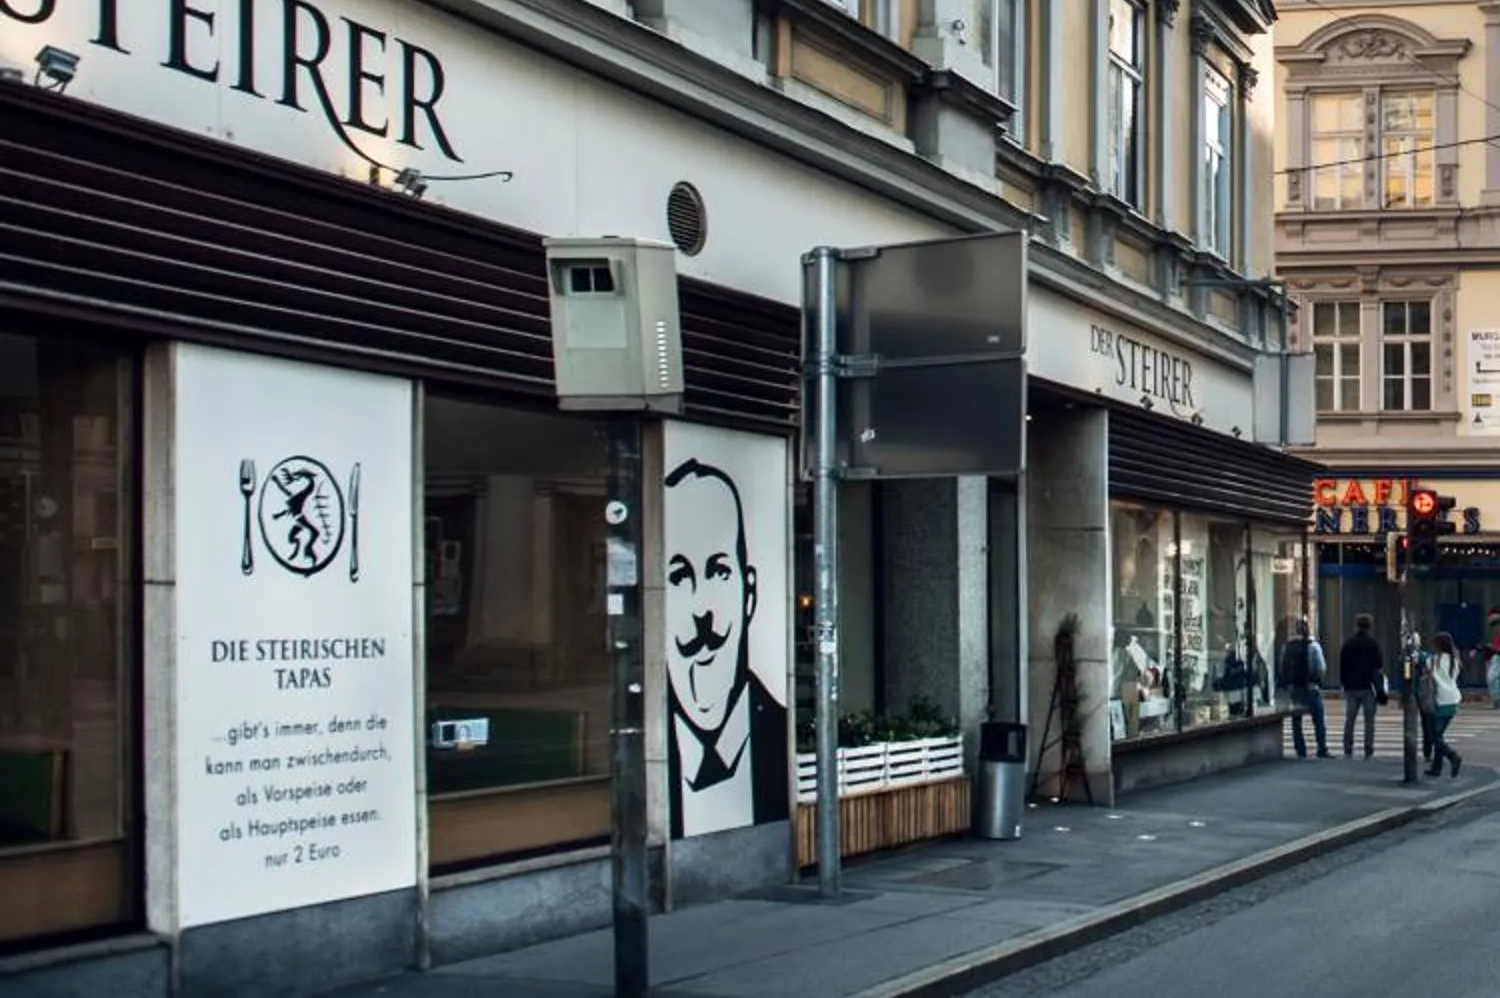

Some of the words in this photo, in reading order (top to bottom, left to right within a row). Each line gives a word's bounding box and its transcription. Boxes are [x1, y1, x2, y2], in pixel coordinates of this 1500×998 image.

[1091, 324, 1115, 359] DER
[1116, 333, 1198, 419] STEIRER
[211, 640, 249, 663] DIE
[255, 638, 386, 661] STEIRISCHEN
[274, 667, 332, 690] TAPAS
[328, 715, 361, 734] denn
[366, 713, 388, 731] die
[205, 755, 243, 775] kann
[249, 756, 280, 772] man
[286, 742, 393, 770] zwischendurch,
[236, 785, 258, 806] als
[263, 783, 332, 803] Vorspeise
[336, 777, 368, 796] oder
[219, 821, 243, 842] als
[247, 814, 337, 838] Hauptspeise
[265, 851, 289, 868] nur
[294, 844, 304, 864] 2
[308, 842, 342, 862] Euro
